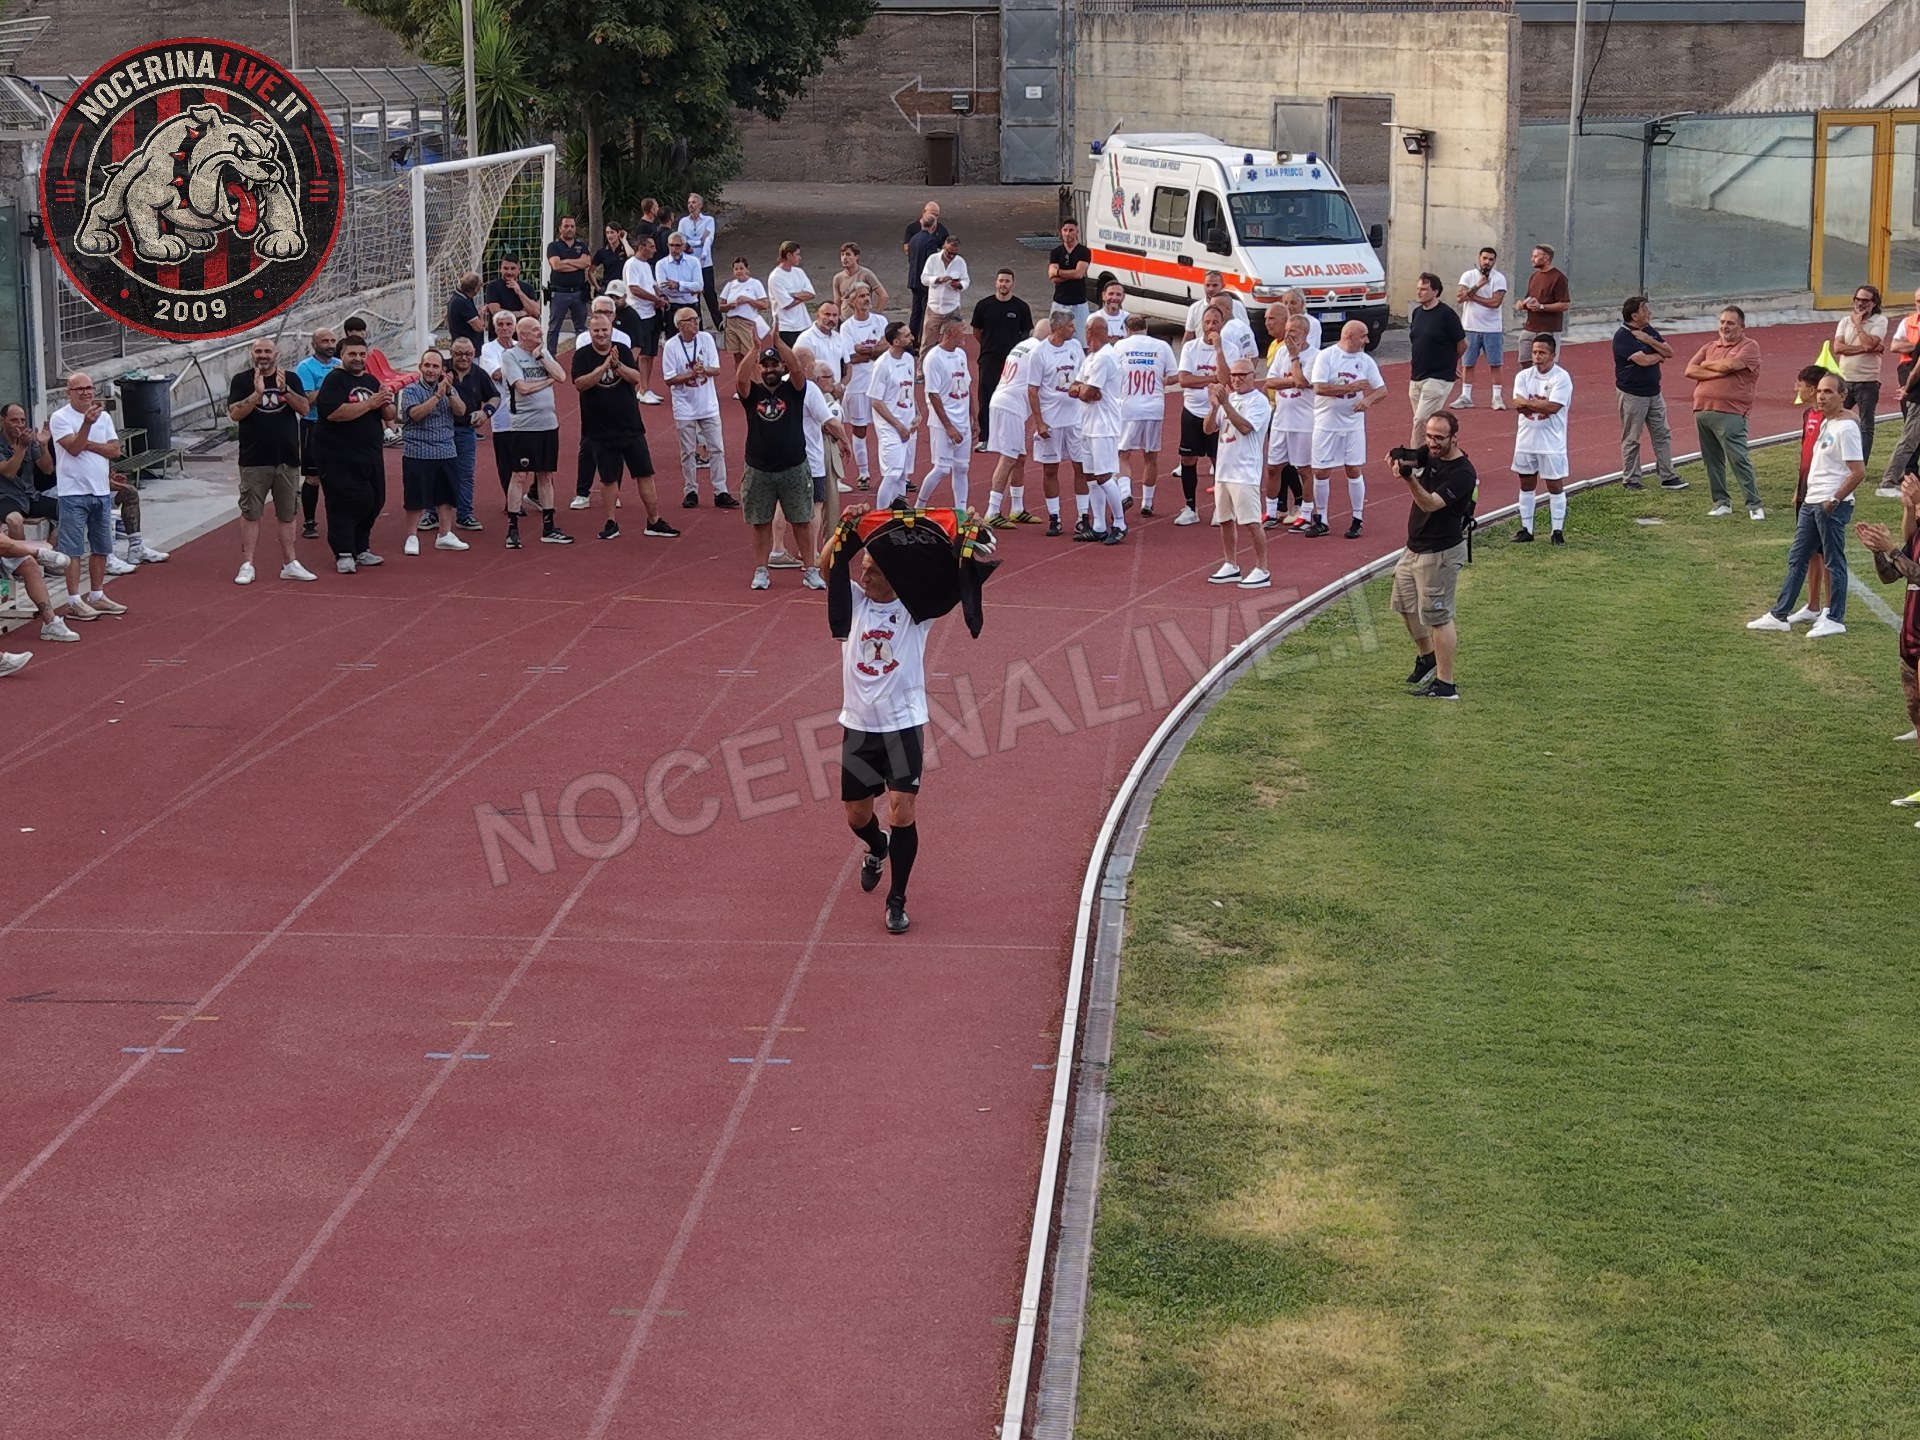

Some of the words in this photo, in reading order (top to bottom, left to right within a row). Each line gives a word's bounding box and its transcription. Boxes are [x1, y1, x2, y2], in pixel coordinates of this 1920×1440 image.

[1265, 168, 1279, 178] SAN
[1280, 167, 1304, 177] PRISCO
[1127, 369, 1156, 396] 1910
